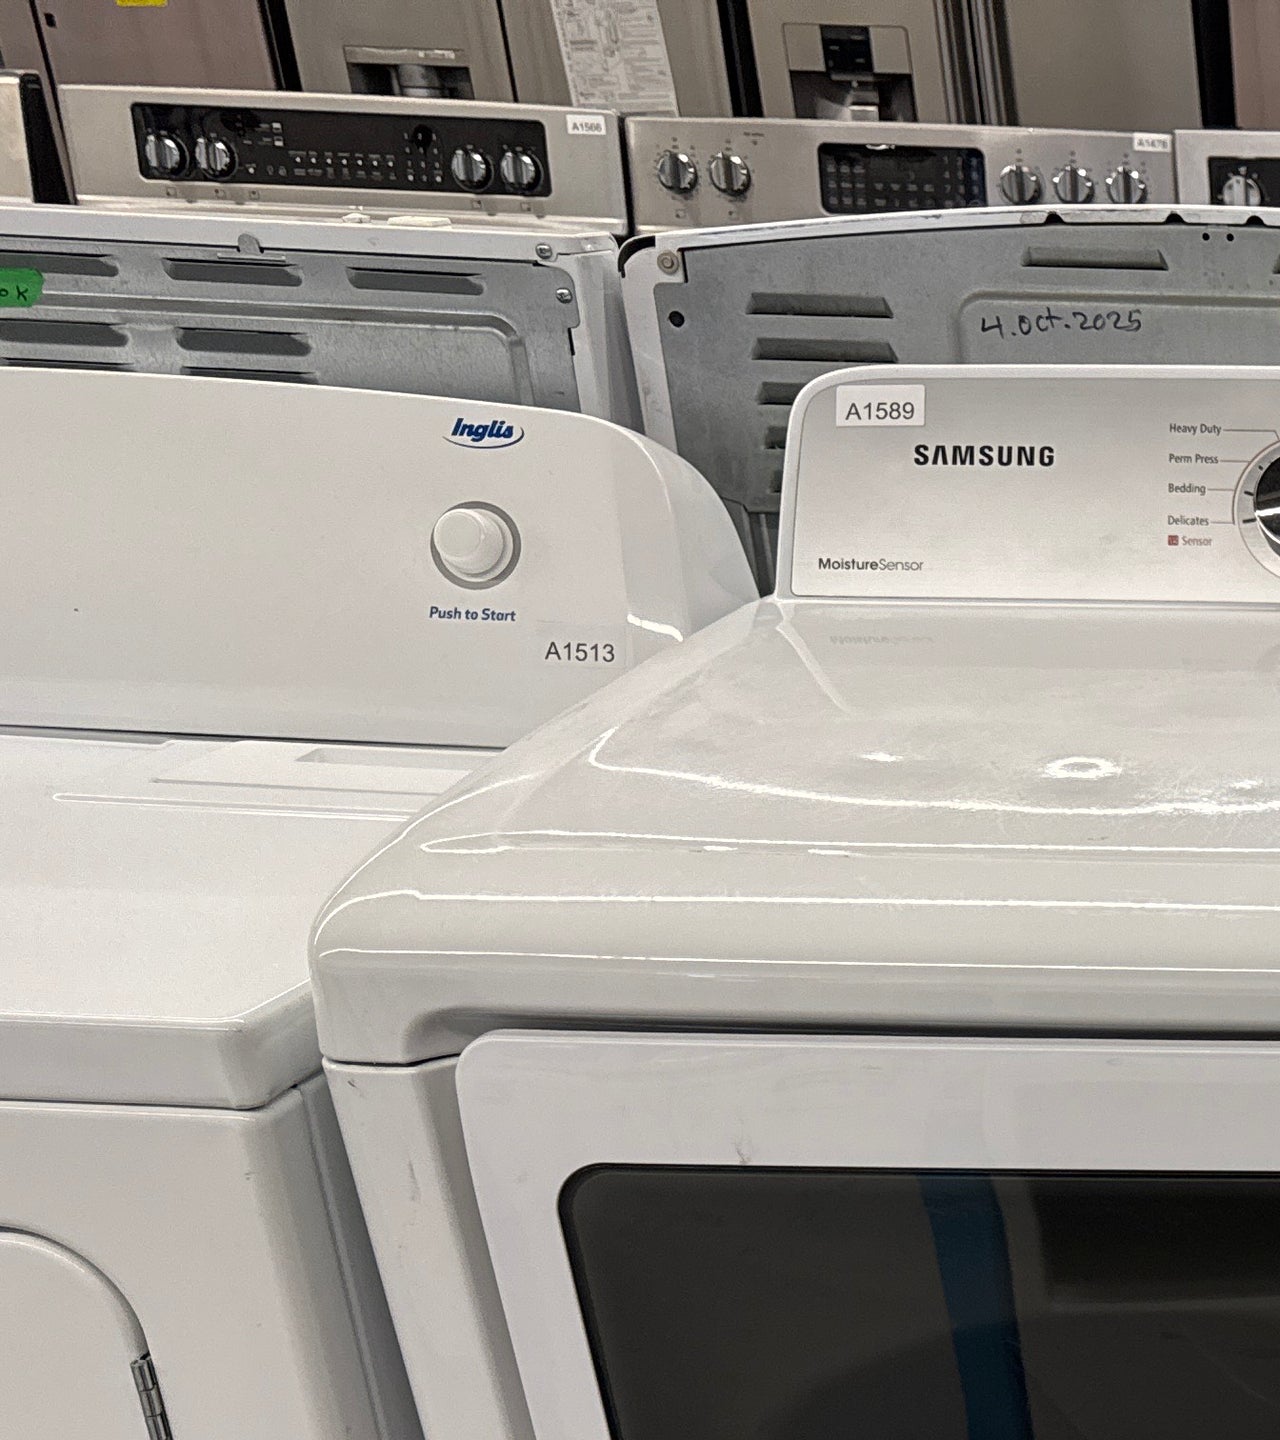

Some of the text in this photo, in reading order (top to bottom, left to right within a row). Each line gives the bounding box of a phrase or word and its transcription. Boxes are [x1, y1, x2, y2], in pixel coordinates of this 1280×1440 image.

[845, 402, 915, 421] A1589
[451, 417, 515, 443] Inglis
[1169, 423, 1222, 436] Heavy Duty
[914, 444, 1055, 467] SAMSUNG
[1168, 453, 1219, 465] Perm Press
[1168, 483, 1206, 496] Bedding
[1168, 515, 1209, 526] Delicates
[1182, 536, 1212, 547] Sensor
[818, 557, 924, 572] MoistureSensor
[429, 606, 516, 621] Push to Start
[545, 641, 615, 662] A1513
